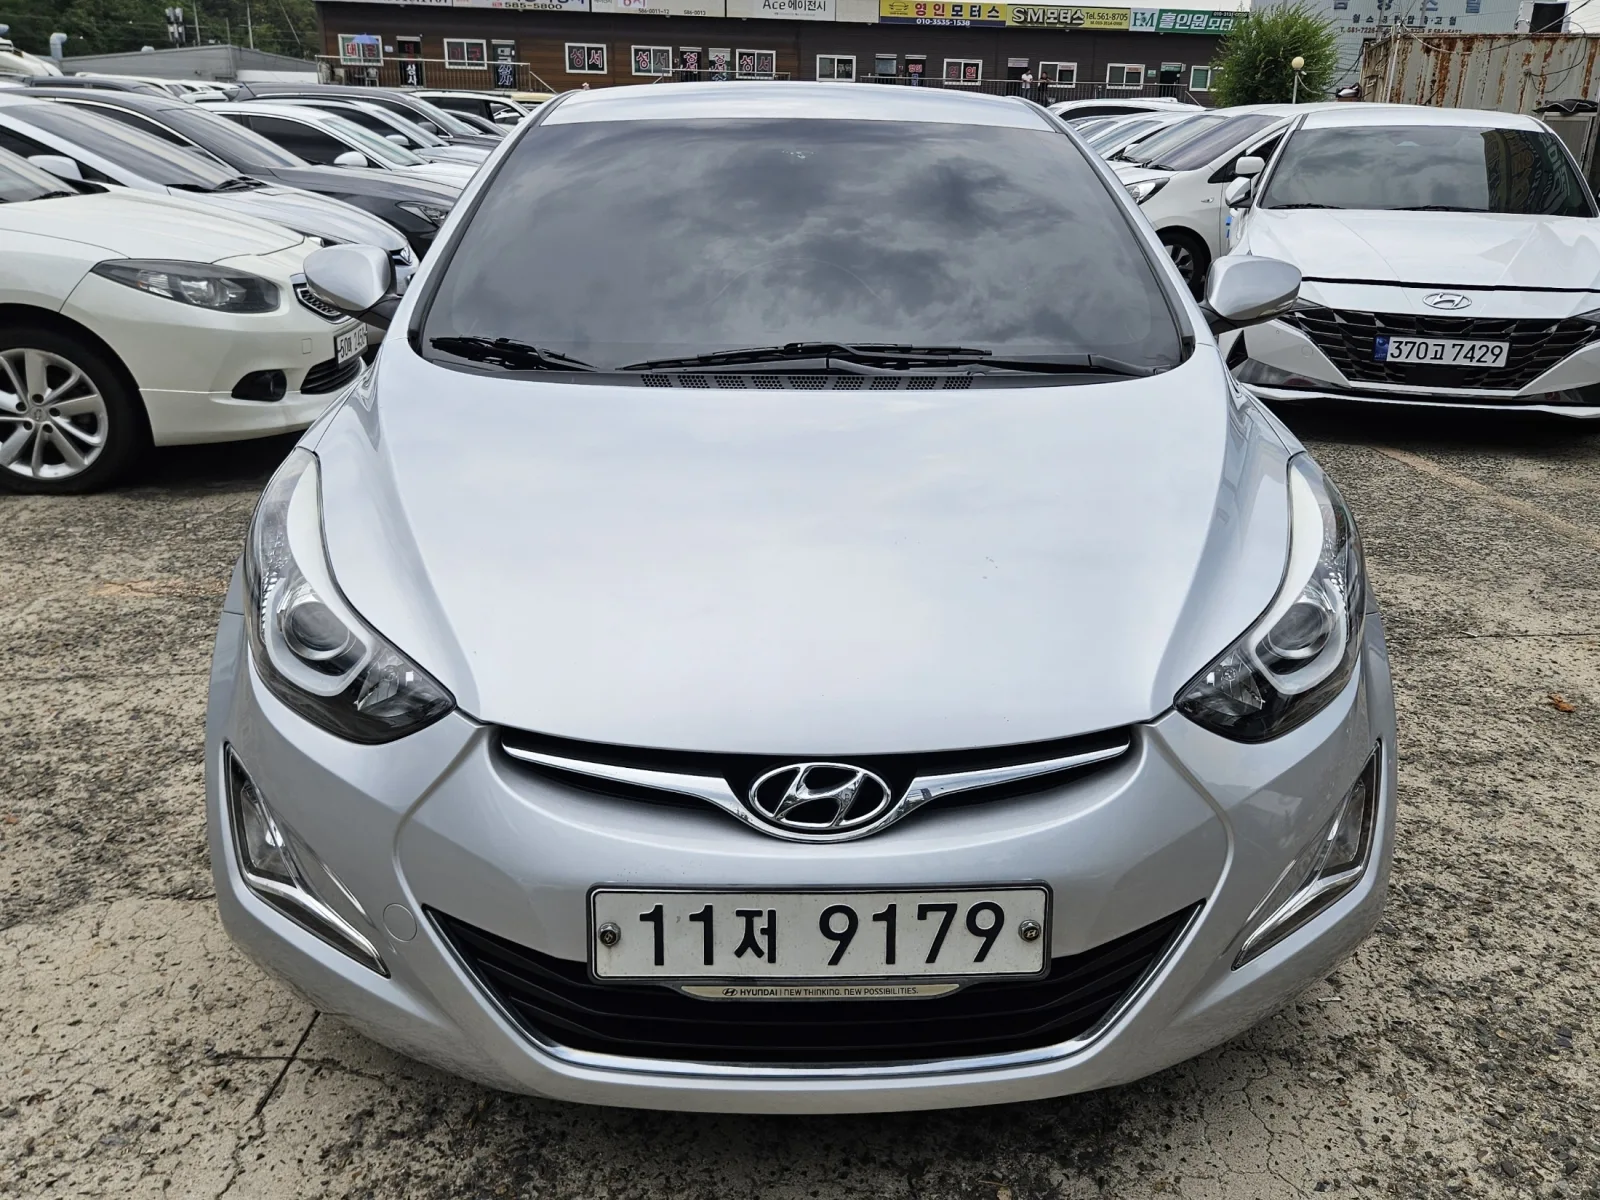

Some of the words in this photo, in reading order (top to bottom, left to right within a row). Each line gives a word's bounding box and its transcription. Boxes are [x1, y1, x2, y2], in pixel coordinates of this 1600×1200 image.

[504, 2, 563, 10] 585-5800
[762, 0, 786, 10] Ace
[787, 0, 826, 12] 에이전시
[1012, 7, 1085, 27] SM모터스
[1159, 12, 1209, 30] 홀인원
[1206, 18, 1238, 31] 모터
[1390, 340, 1446, 361] 370고
[1451, 343, 1504, 364] 7429
[639, 903, 777, 966] 11저
[818, 901, 1006, 966] 9179
[740, 988, 778, 997] HYUNDAI
